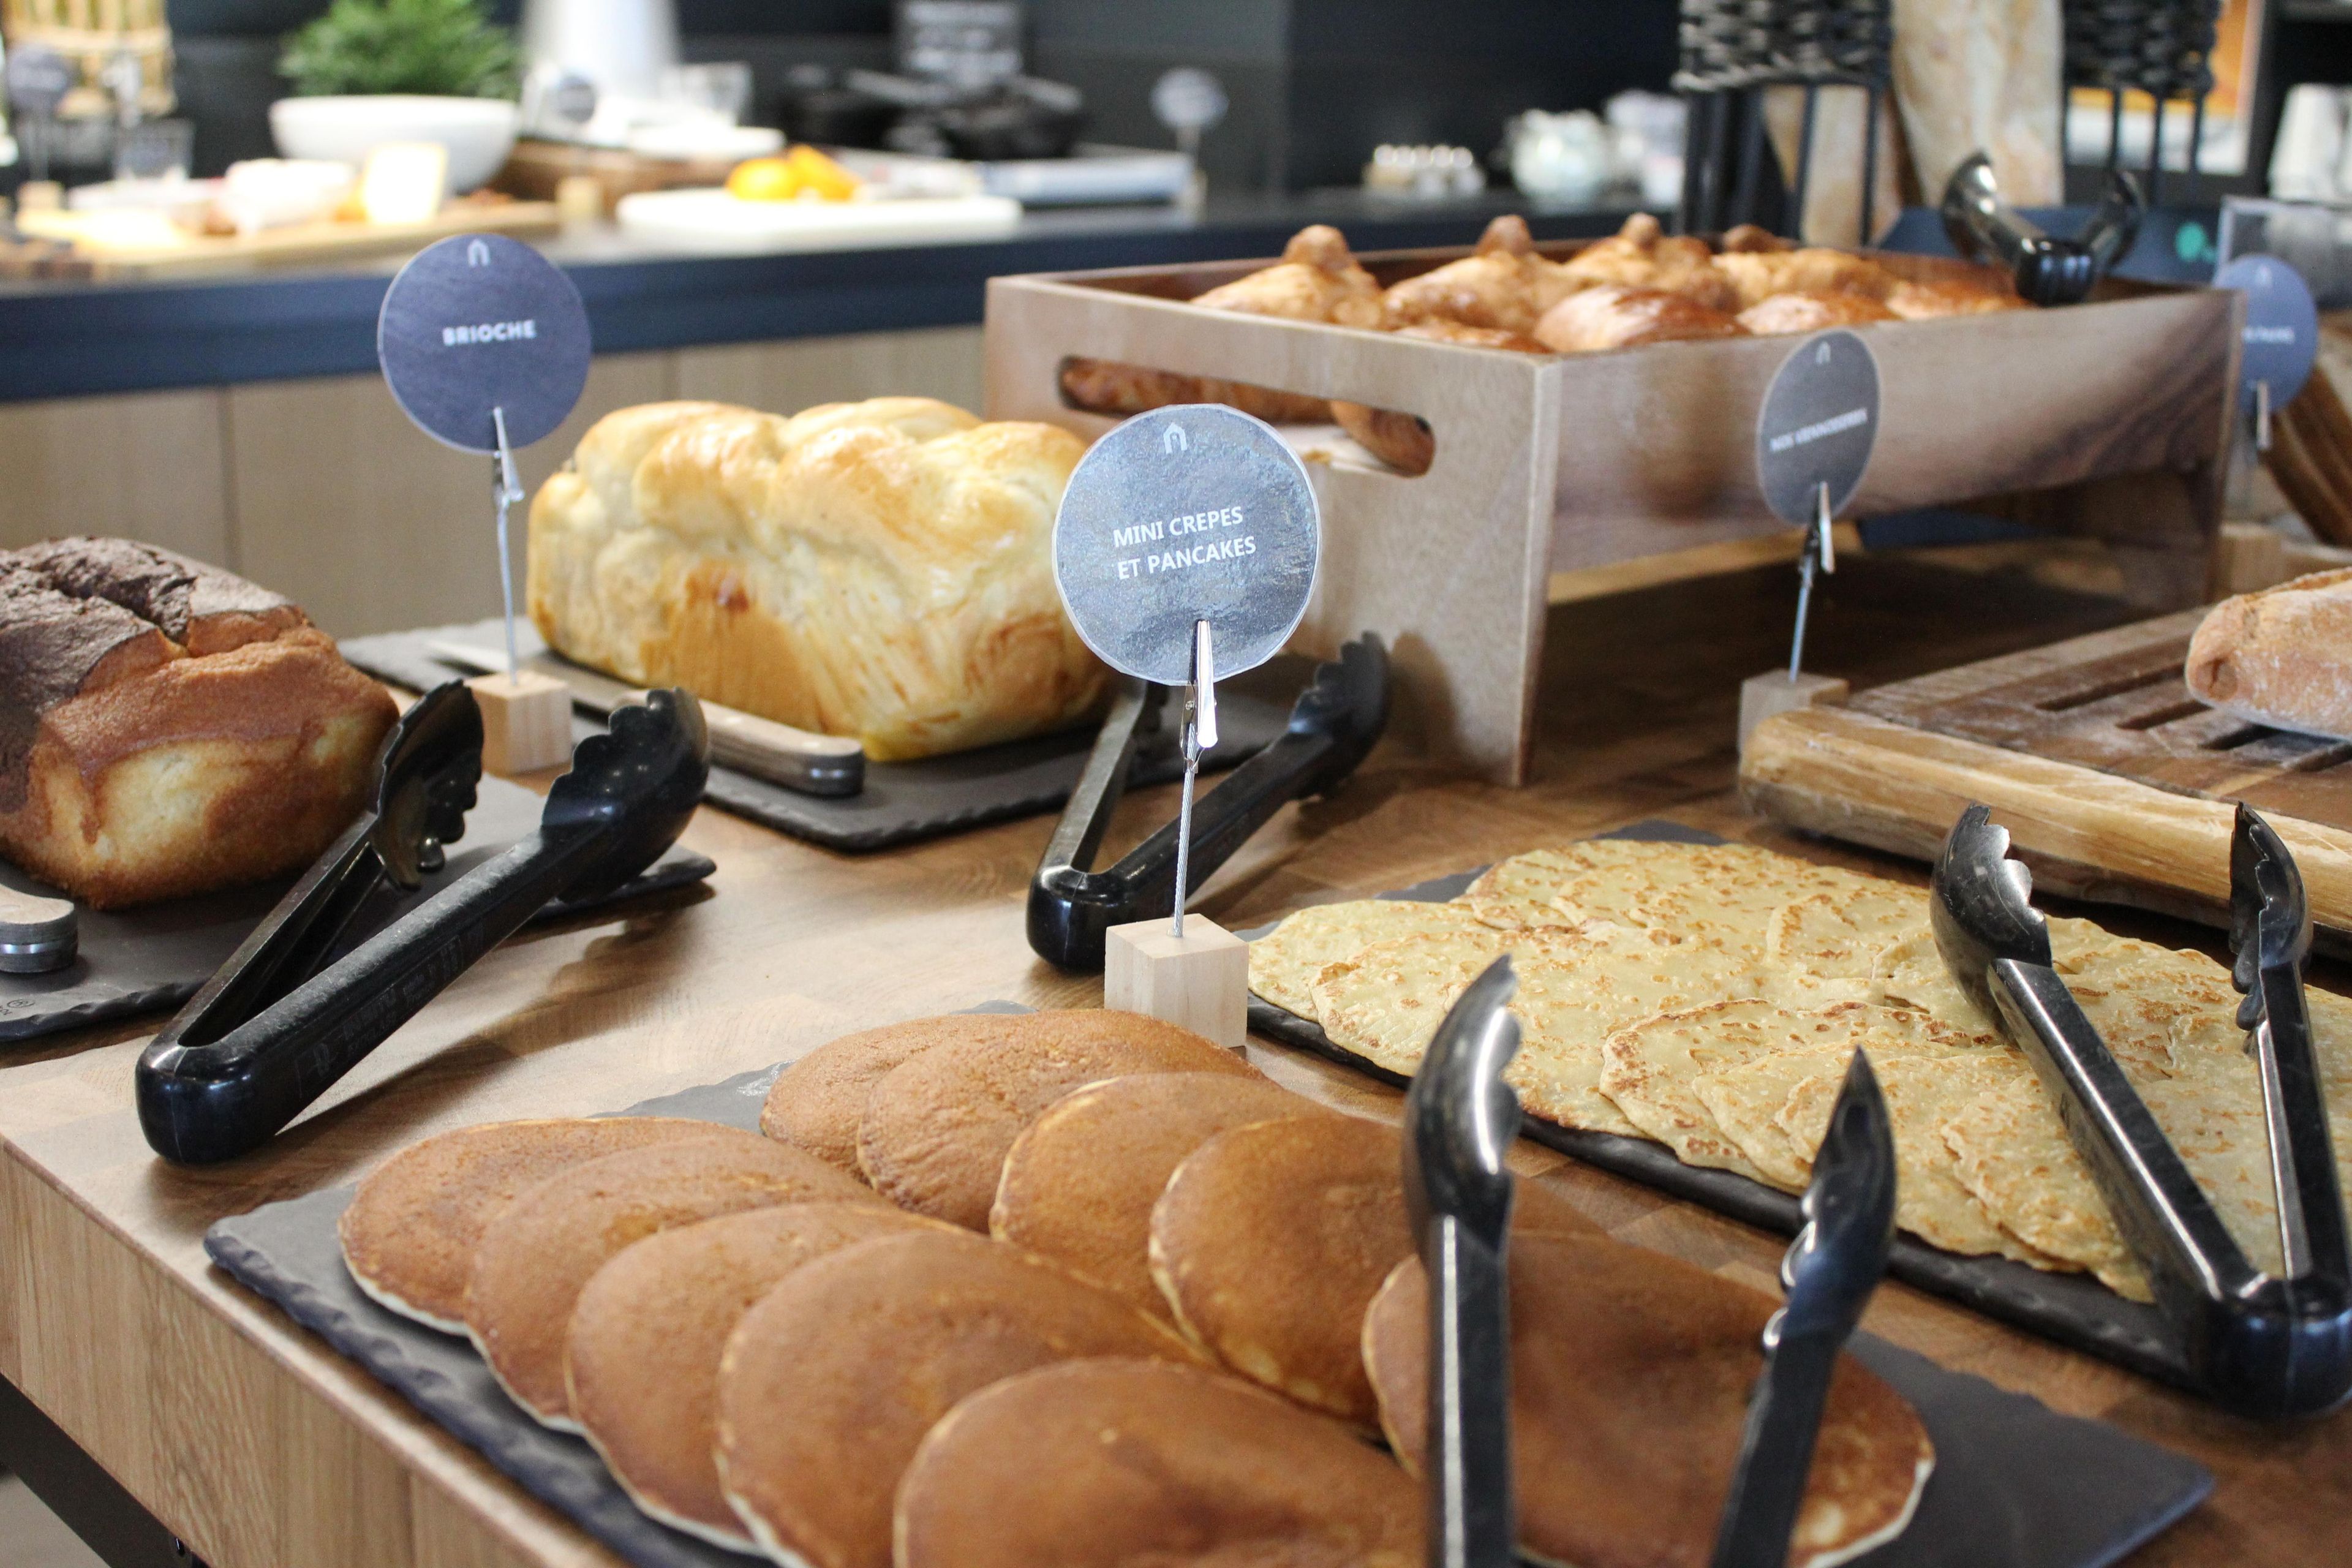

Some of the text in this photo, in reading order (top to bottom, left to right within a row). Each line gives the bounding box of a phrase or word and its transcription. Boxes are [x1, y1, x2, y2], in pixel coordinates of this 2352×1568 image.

[442, 319, 536, 347] BRIOCHE
[1112, 506, 1244, 548] MINI CREPES
[1117, 535, 1257, 580] ET PANCAKES
